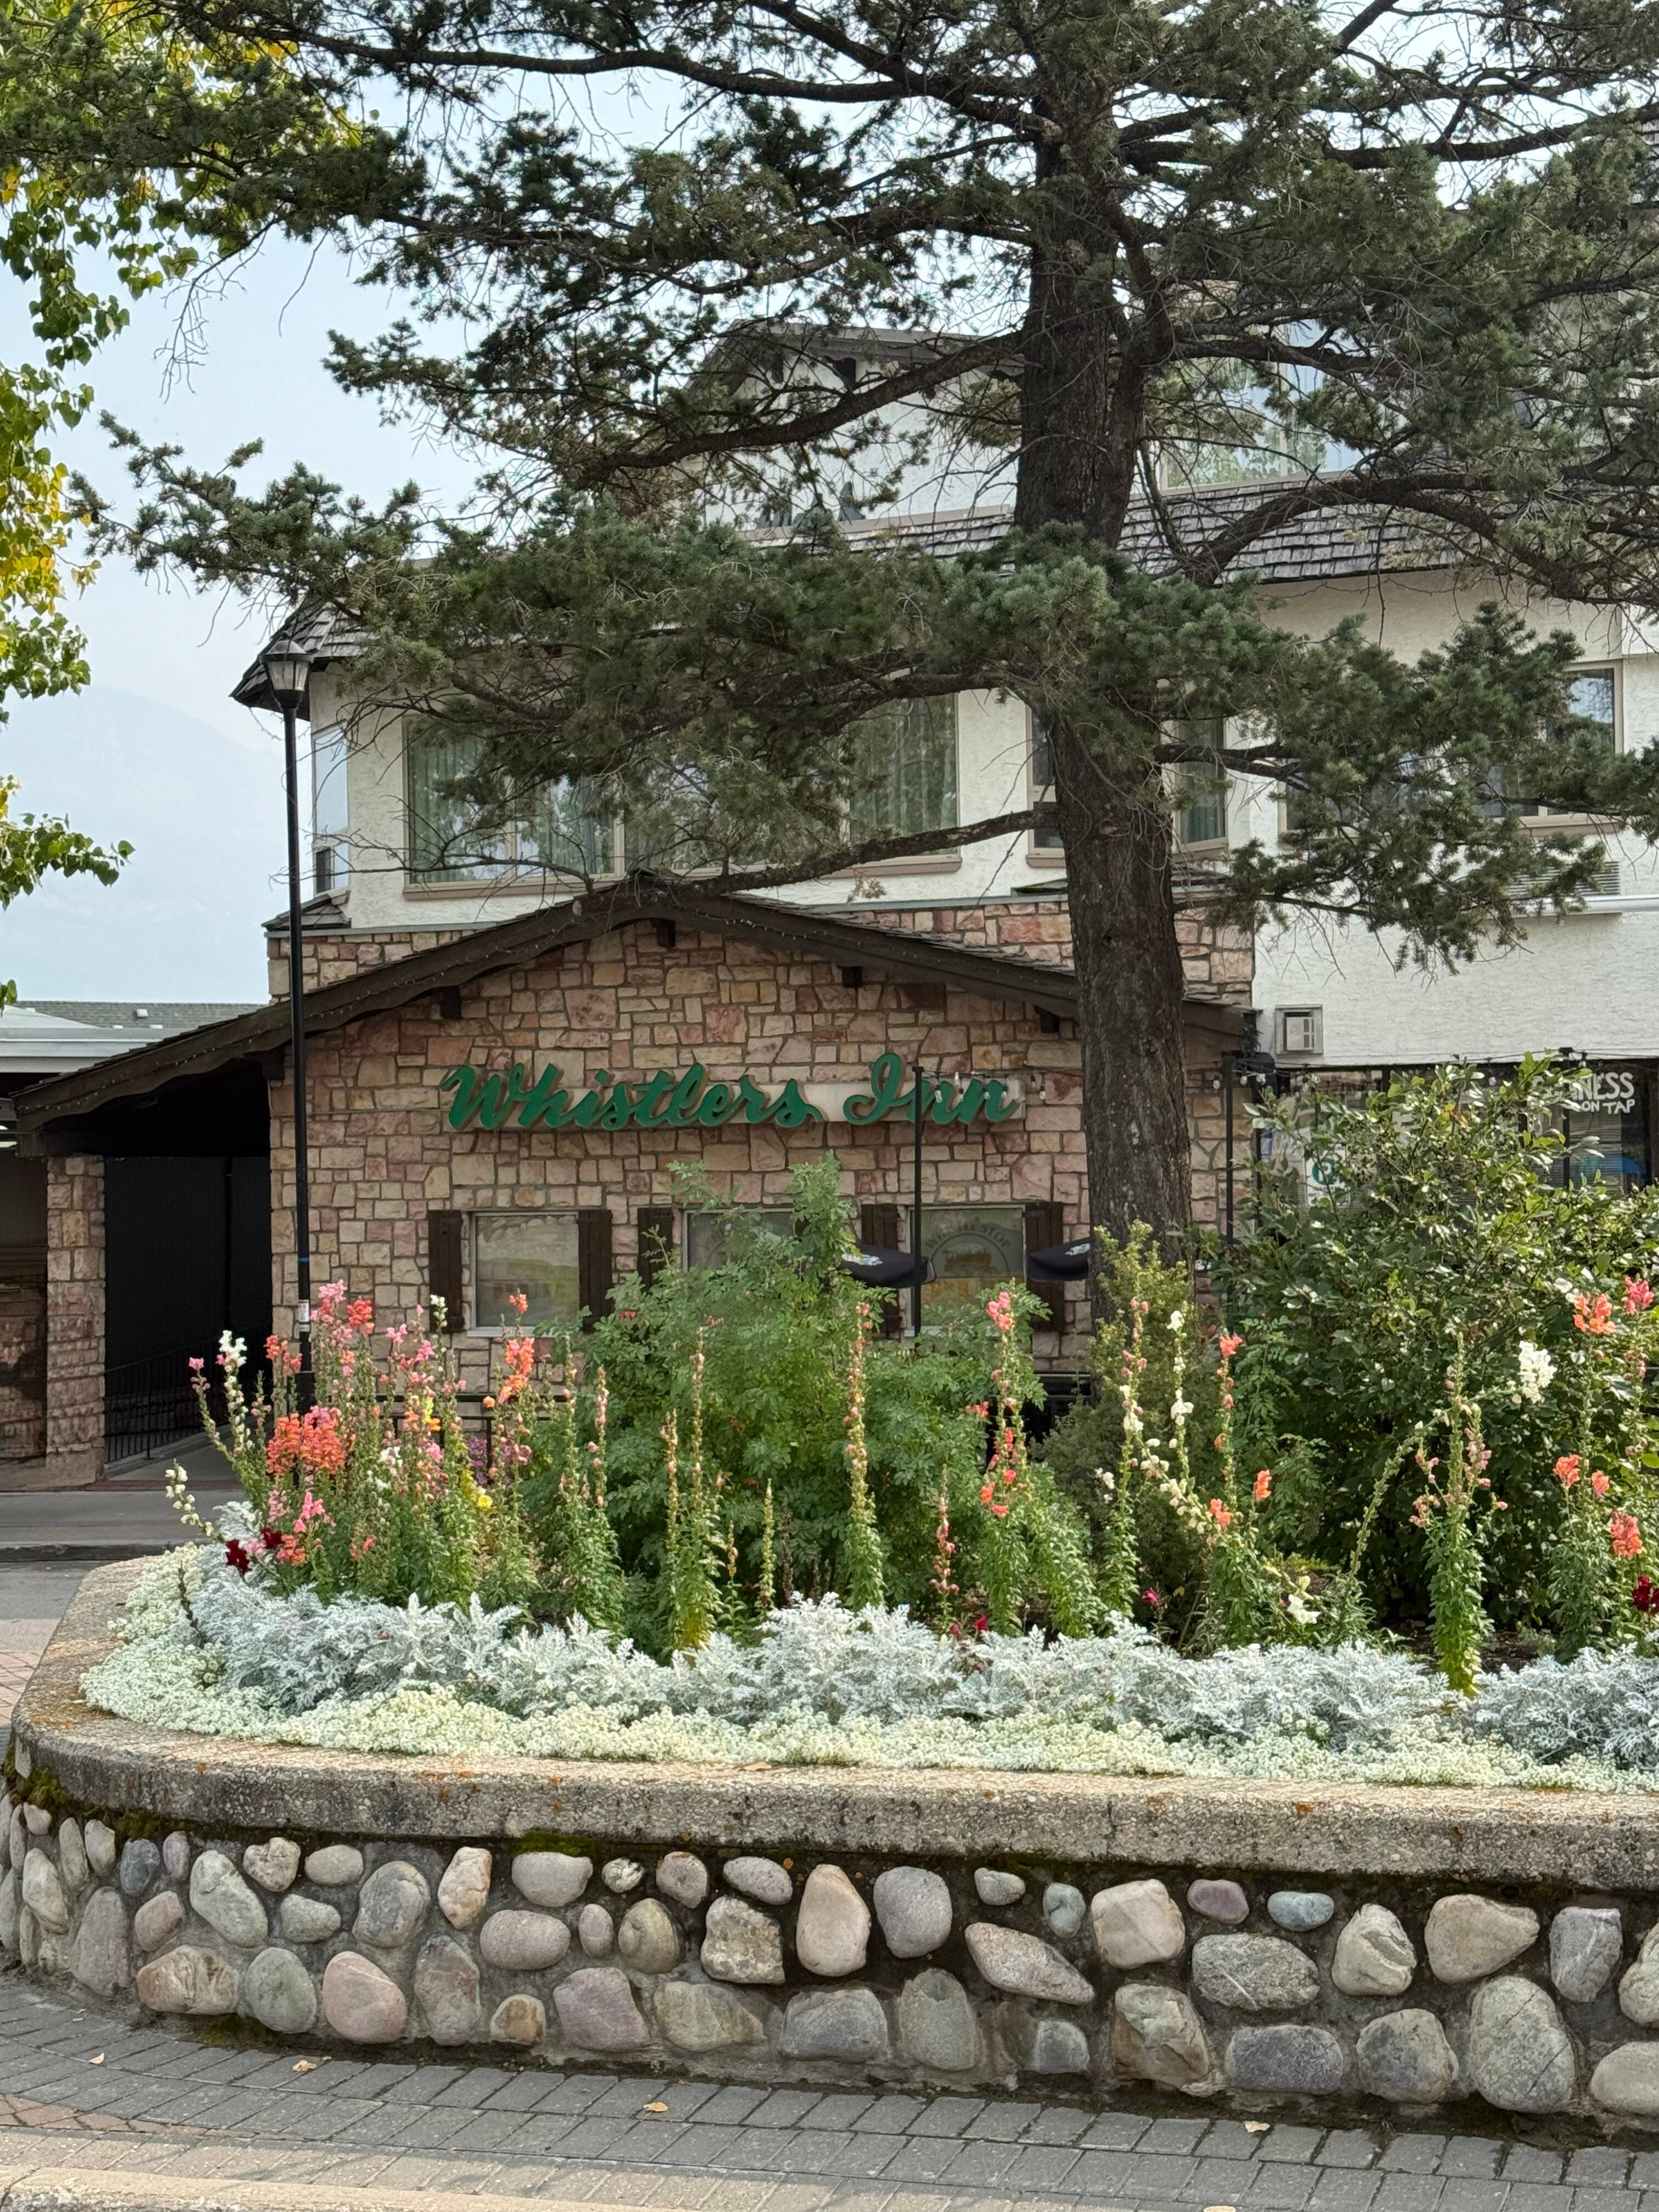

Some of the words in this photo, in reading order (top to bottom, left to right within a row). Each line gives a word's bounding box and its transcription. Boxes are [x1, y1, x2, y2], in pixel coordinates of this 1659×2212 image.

[440, 1063, 825, 1130] Whistlers
[843, 1052, 1022, 1125] Inn
[1582, 1101, 1600, 1113] ON
[1602, 1099, 1635, 1114] TAP
[981, 1223, 1011, 1248] STOP
